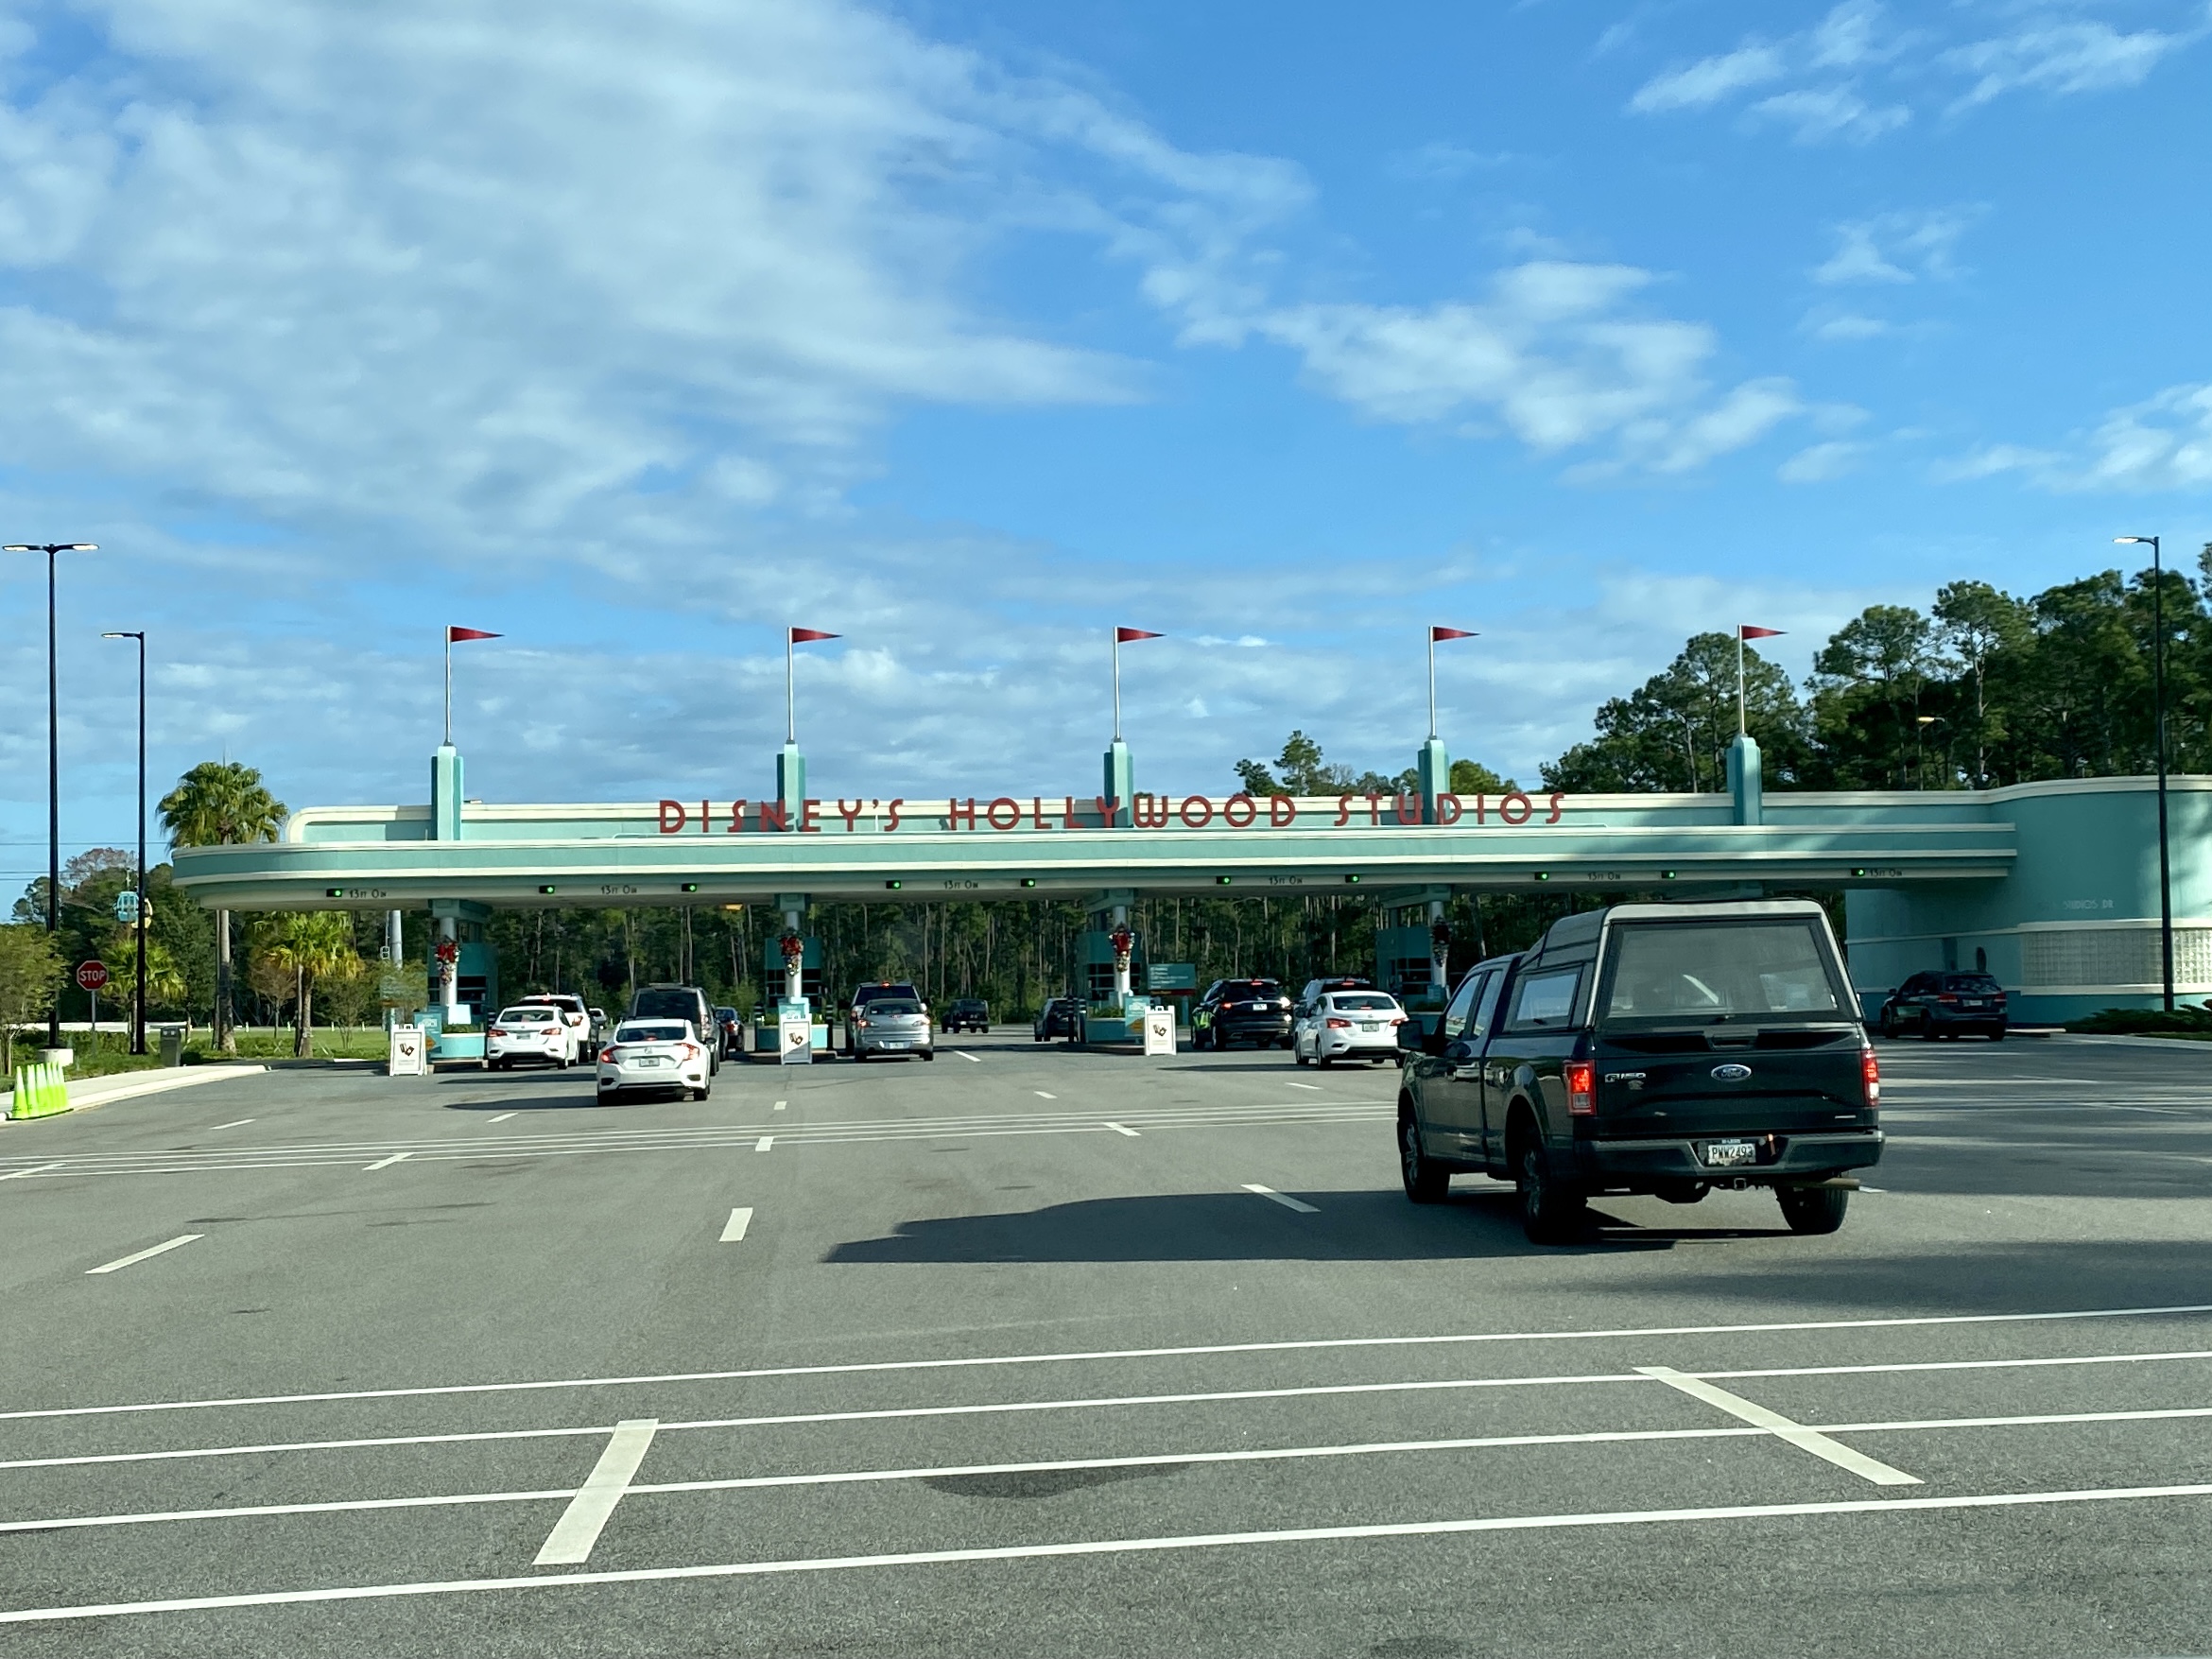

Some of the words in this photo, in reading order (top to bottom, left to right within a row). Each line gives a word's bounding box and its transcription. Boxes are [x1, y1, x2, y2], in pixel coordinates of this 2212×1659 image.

[659, 799, 904, 833] DISNEY'S
[949, 795, 1296, 831] HOLLYWOOD
[1334, 792, 1565, 826] STUDIOS
[79, 970, 106, 982] STOP
